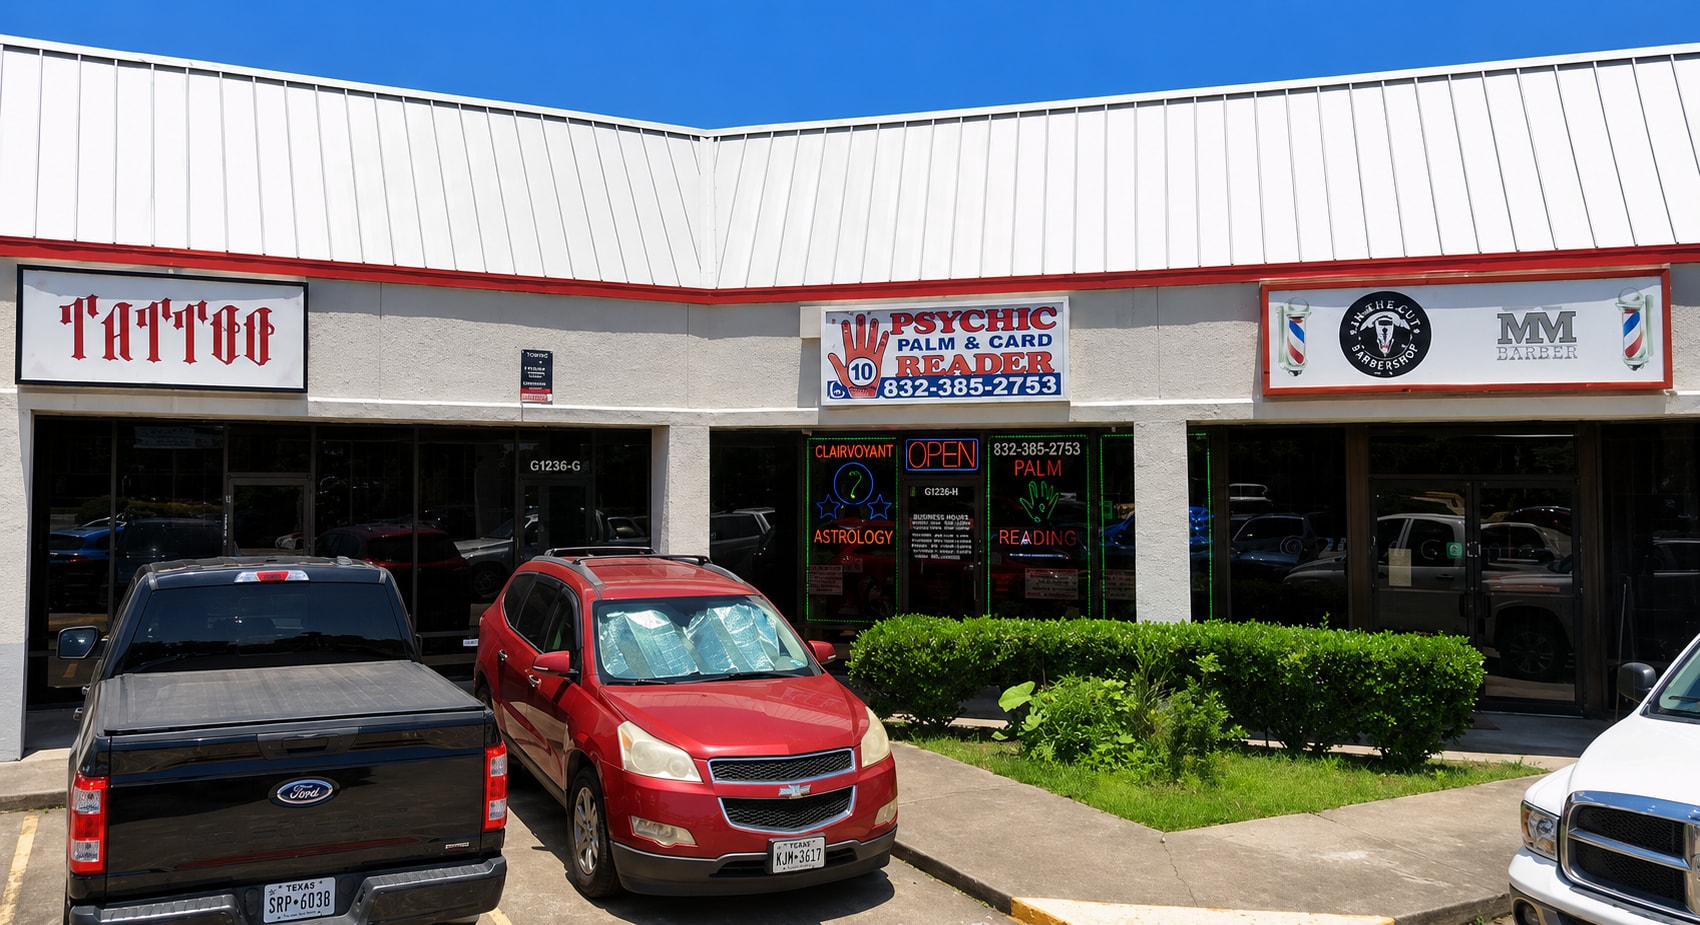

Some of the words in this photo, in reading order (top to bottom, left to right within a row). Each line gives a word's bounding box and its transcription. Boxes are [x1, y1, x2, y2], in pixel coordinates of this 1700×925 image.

[890, 307, 1057, 335] PSYCHIC
[1365, 300, 1395, 313] THE
[1398, 304, 1421, 327] CUT
[59, 294, 275, 367] TATTOO
[1497, 311, 1577, 344] MM
[897, 337, 955, 352] PALM
[964, 336, 981, 350] &
[988, 333, 1053, 349] CARD
[1351, 343, 1418, 370] BARBERSHOP
[1496, 345, 1578, 361] BARBER
[850, 362, 873, 381] 10
[895, 351, 1056, 377] READER
[883, 376, 1057, 398] 832-385-2753
[815, 444, 894, 458] CLAIRVOYANT
[908, 441, 975, 469] OPEN
[993, 441, 1081, 456] 832-385-2753
[530, 460, 581, 471] G1236-G
[1014, 459, 1062, 477] PALM
[924, 487, 959, 496] G1226-H
[814, 529, 893, 545] ASTROLOGY
[999, 529, 1077, 546] READING
[289, 784, 320, 799] Ford
[286, 882, 315, 892] TEXAS
